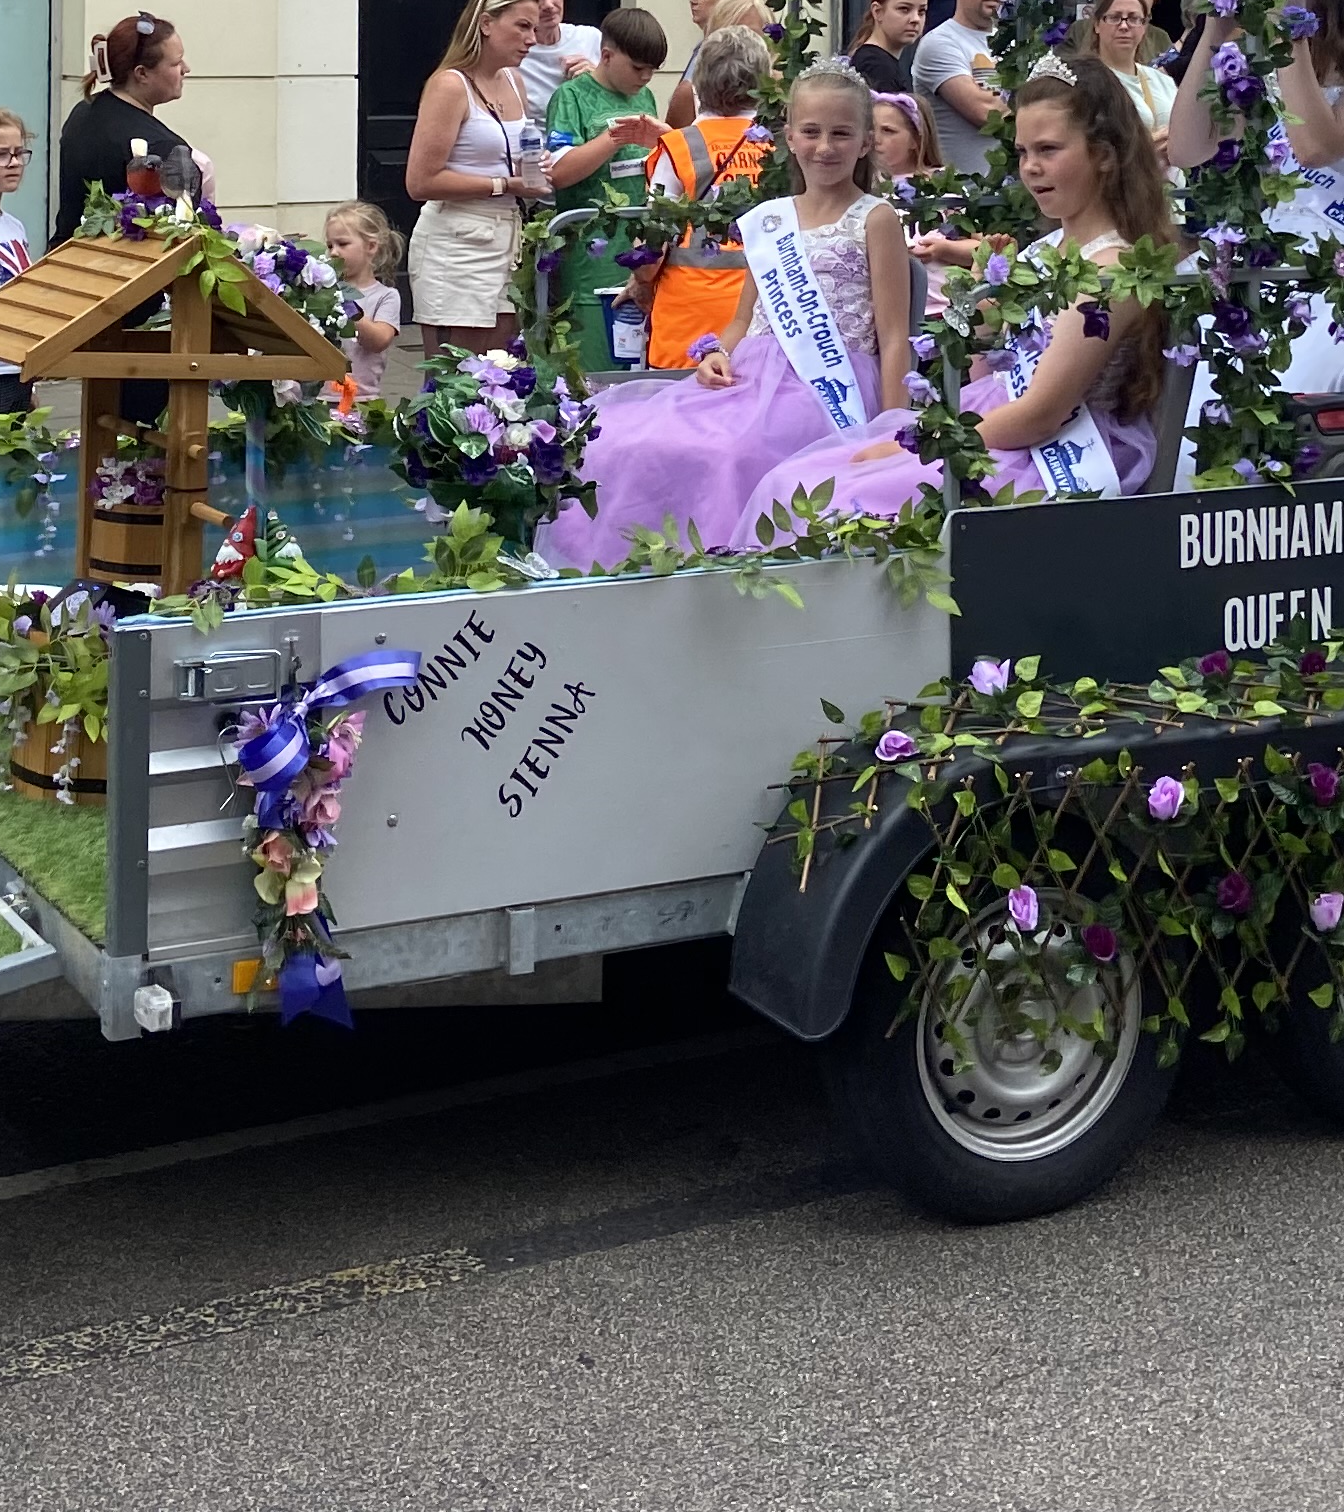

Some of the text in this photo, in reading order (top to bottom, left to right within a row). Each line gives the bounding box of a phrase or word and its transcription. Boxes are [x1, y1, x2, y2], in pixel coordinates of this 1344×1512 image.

[761, 267, 803, 339] Princess
[776, 231, 845, 369] Burnham-On-Crouch
[1179, 500, 1344, 569] BURNHAM
[383, 609, 495, 726] CONNIE
[461, 641, 548, 751] HONEY
[498, 681, 596, 819] SIENNA
